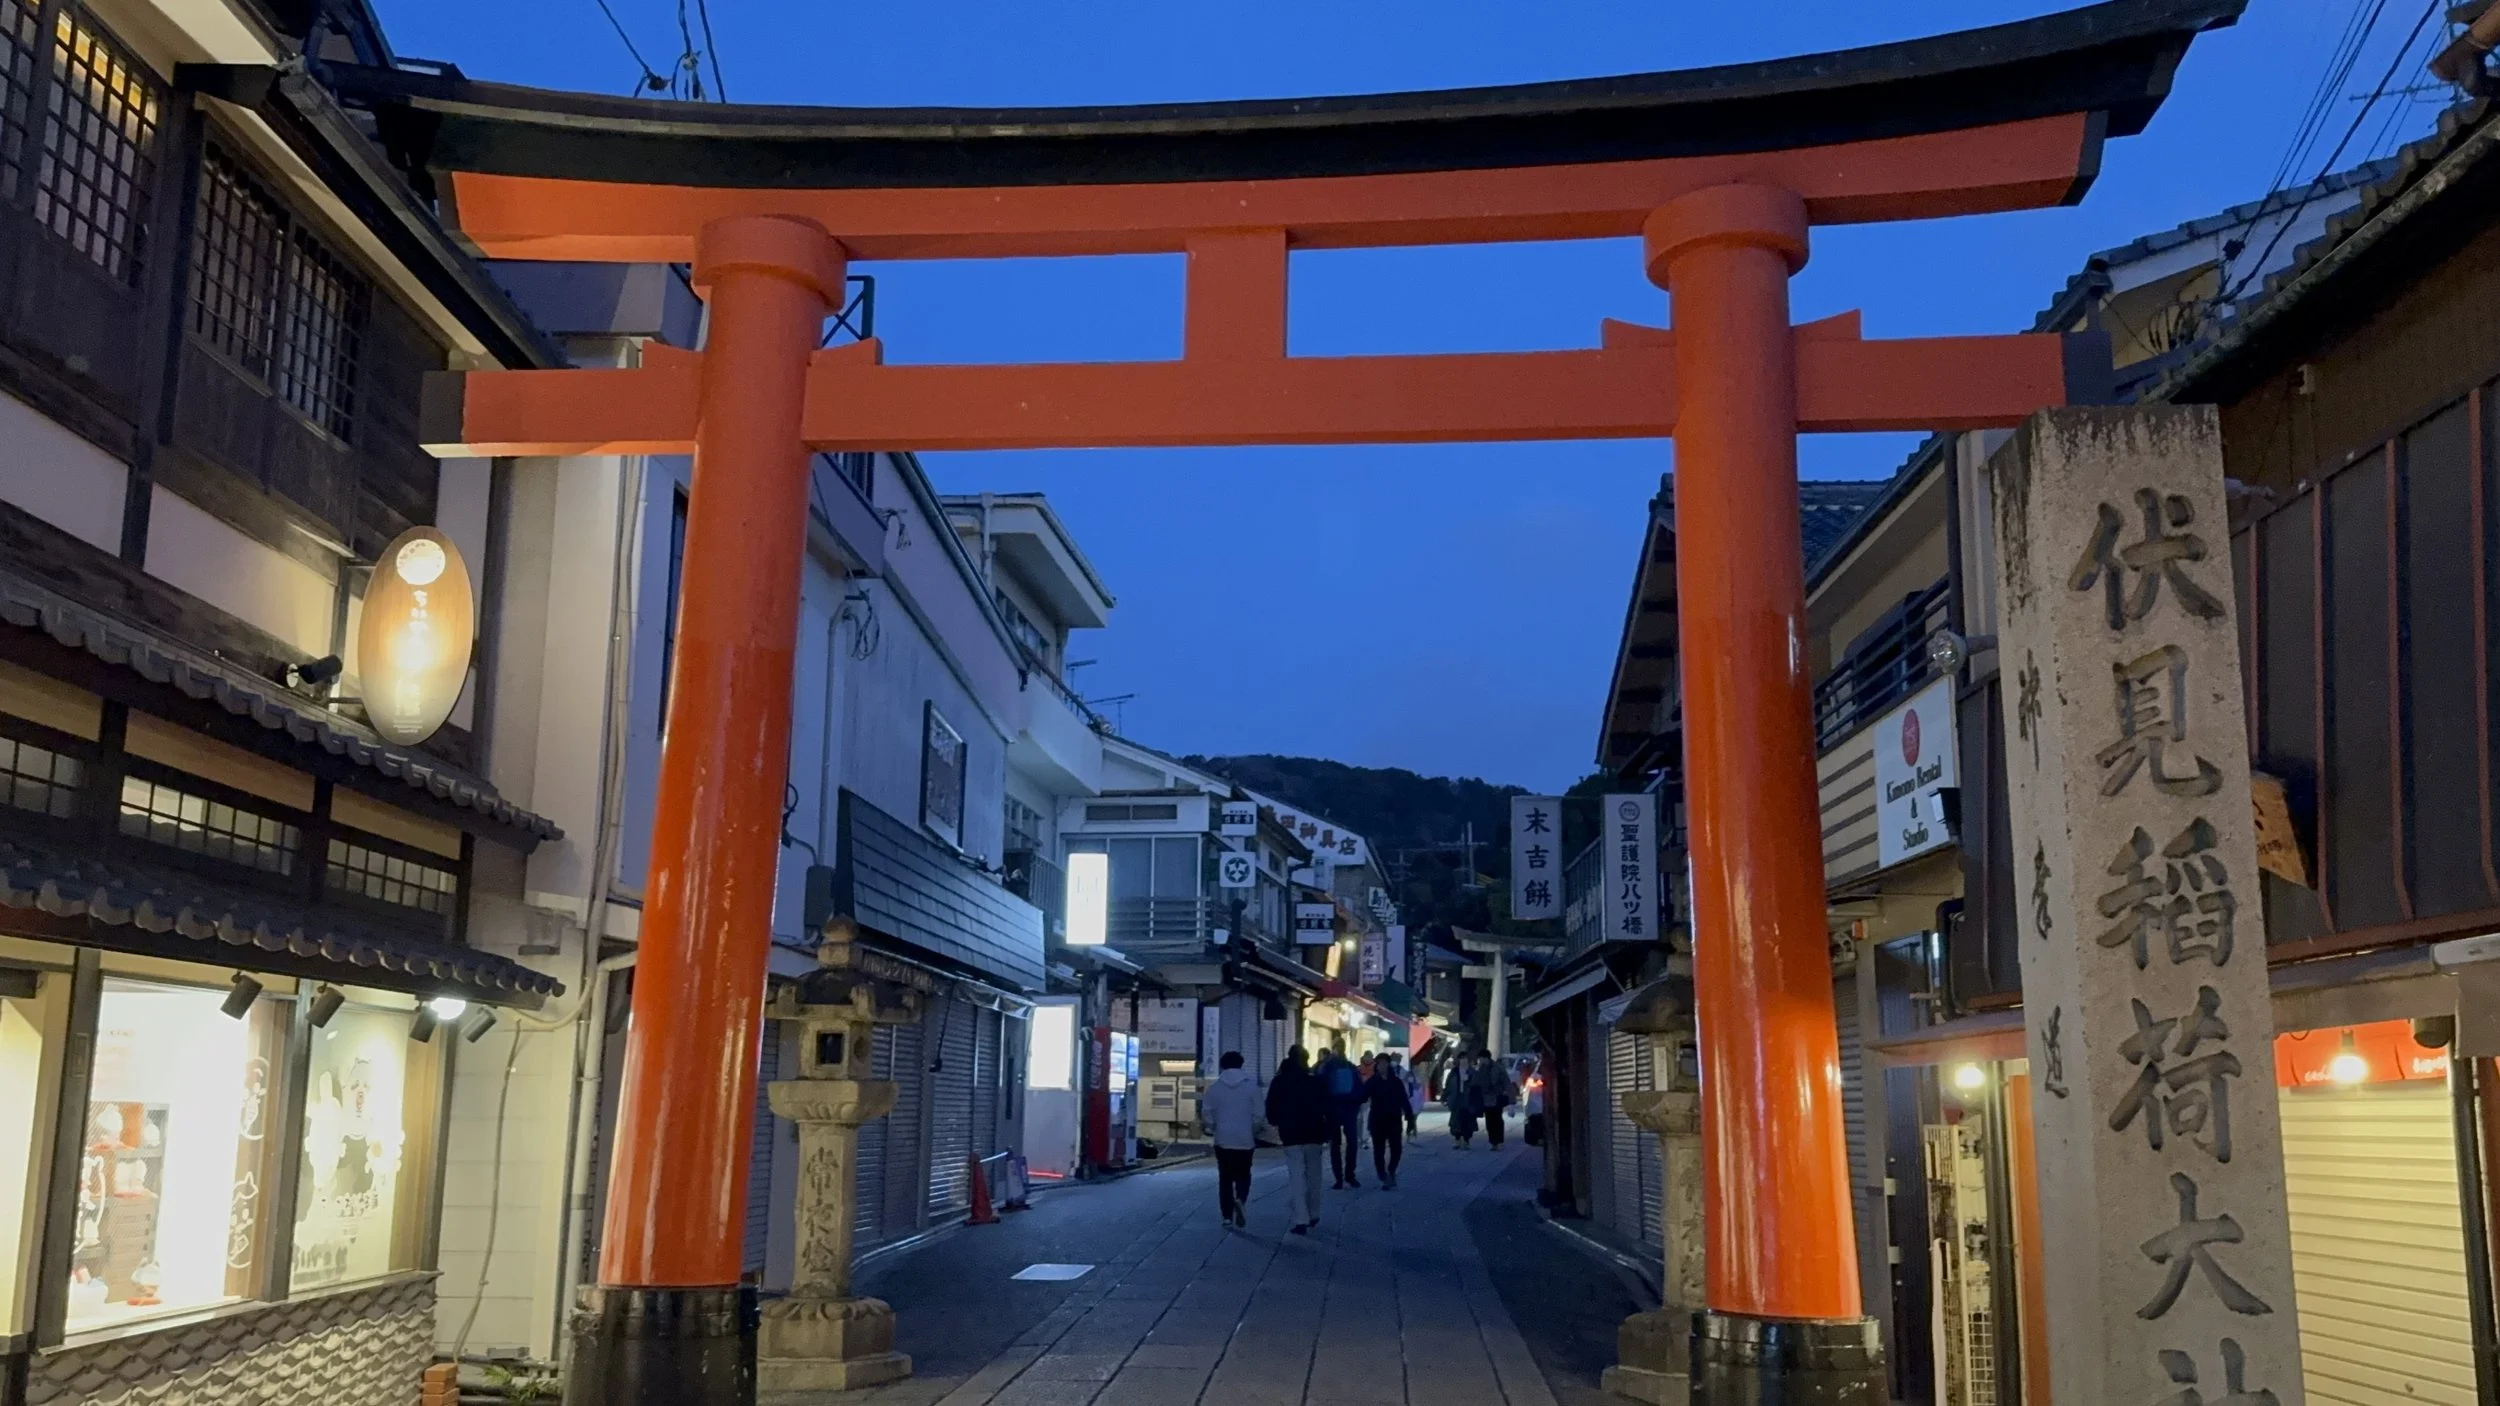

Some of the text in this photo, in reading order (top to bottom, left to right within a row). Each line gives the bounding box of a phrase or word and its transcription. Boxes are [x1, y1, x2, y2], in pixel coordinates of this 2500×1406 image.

[1886, 756, 1942, 804] Kimono Rental
[1523, 806, 1553, 909] 末吉餅
[1903, 822, 1929, 850] Studio
[1619, 823, 1645, 936] 聖護院八ツ橋
